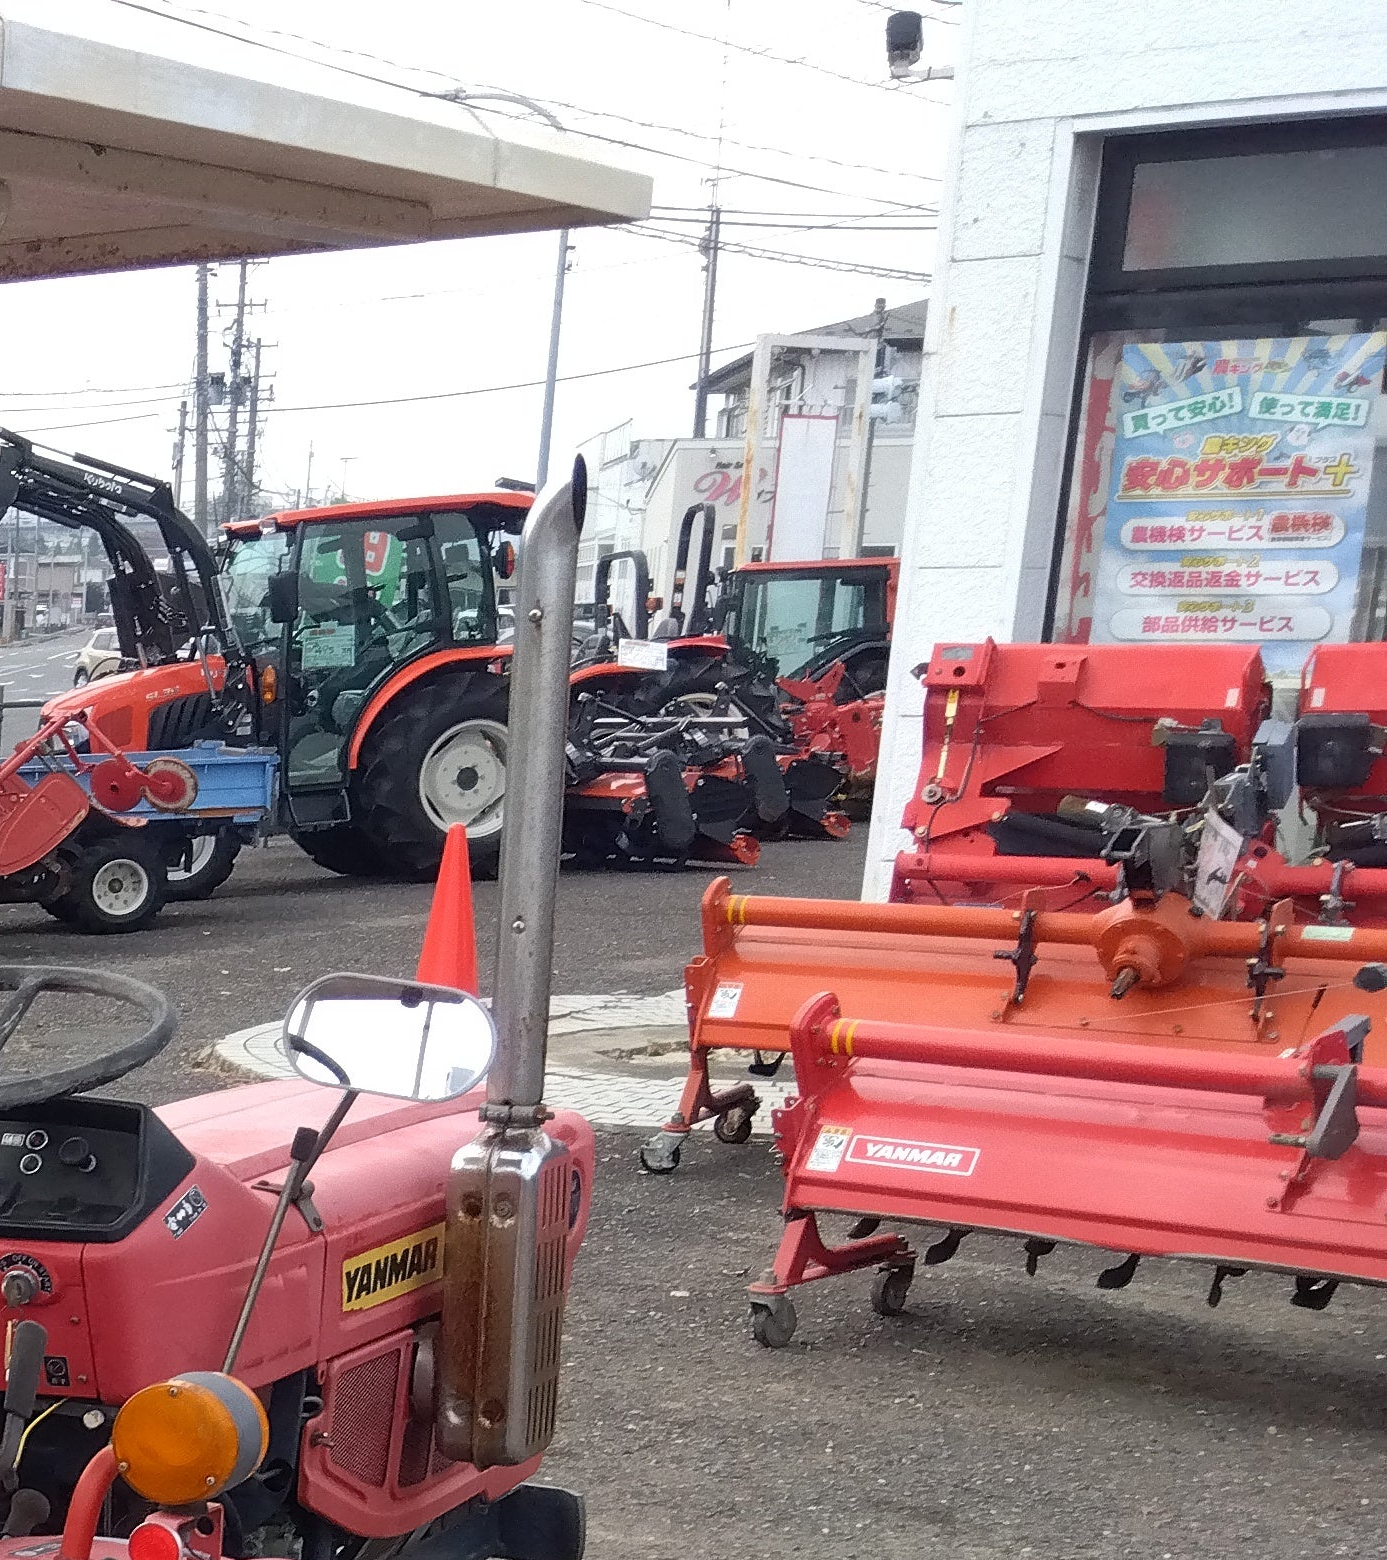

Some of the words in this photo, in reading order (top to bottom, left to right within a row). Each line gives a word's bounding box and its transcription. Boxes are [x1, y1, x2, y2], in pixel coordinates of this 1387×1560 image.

[83, 472, 123, 495] Kubota
[864, 1142, 964, 1168] YANMAR
[345, 1236, 439, 1304] YANMAR
